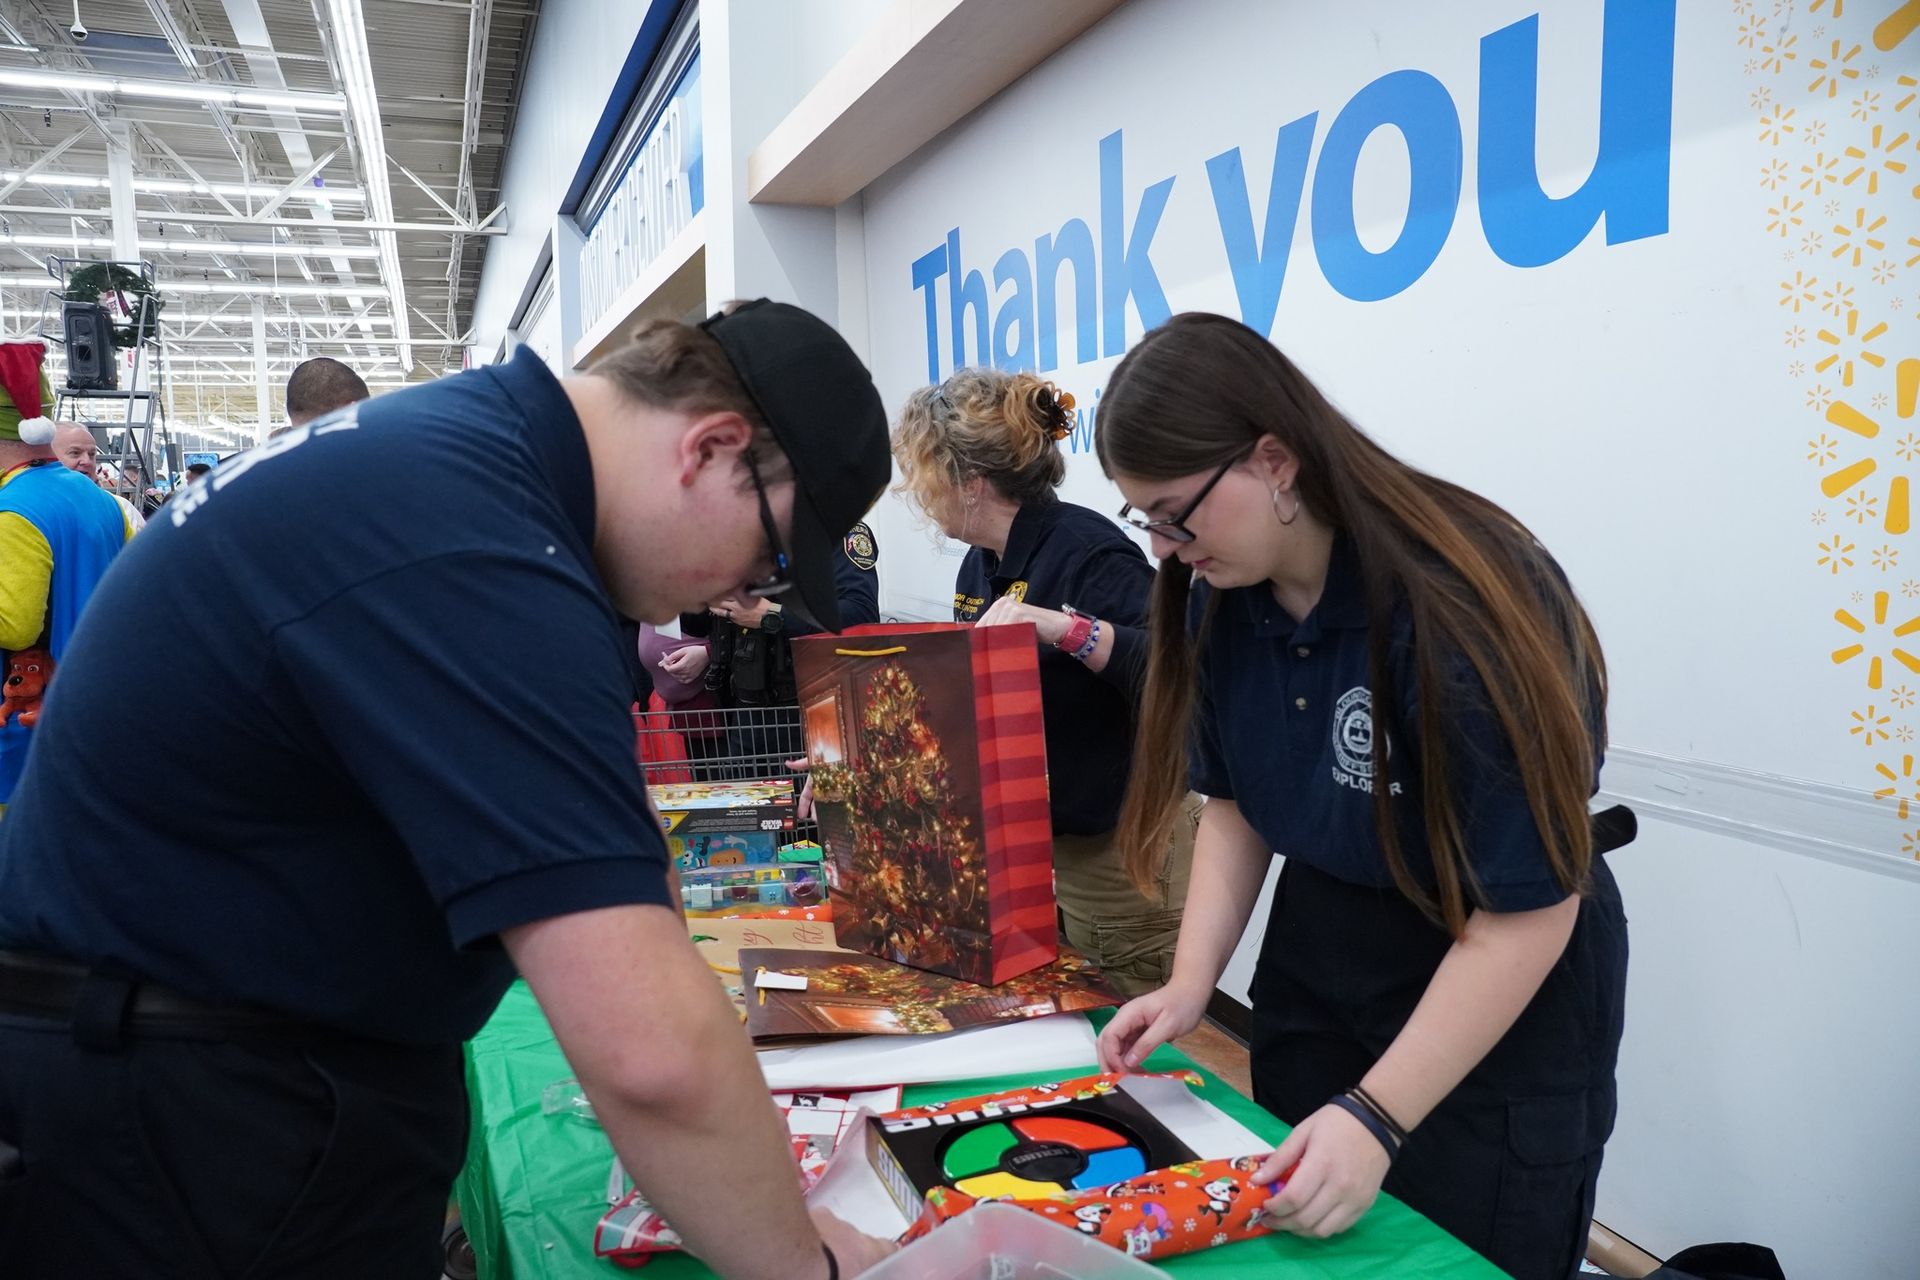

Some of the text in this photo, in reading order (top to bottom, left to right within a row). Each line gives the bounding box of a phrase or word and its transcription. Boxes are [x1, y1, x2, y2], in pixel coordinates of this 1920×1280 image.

[627, 97, 691, 281] CENTER
[911, 0, 1676, 389] Thank you
[1332, 766, 1403, 796] EXPLORR
